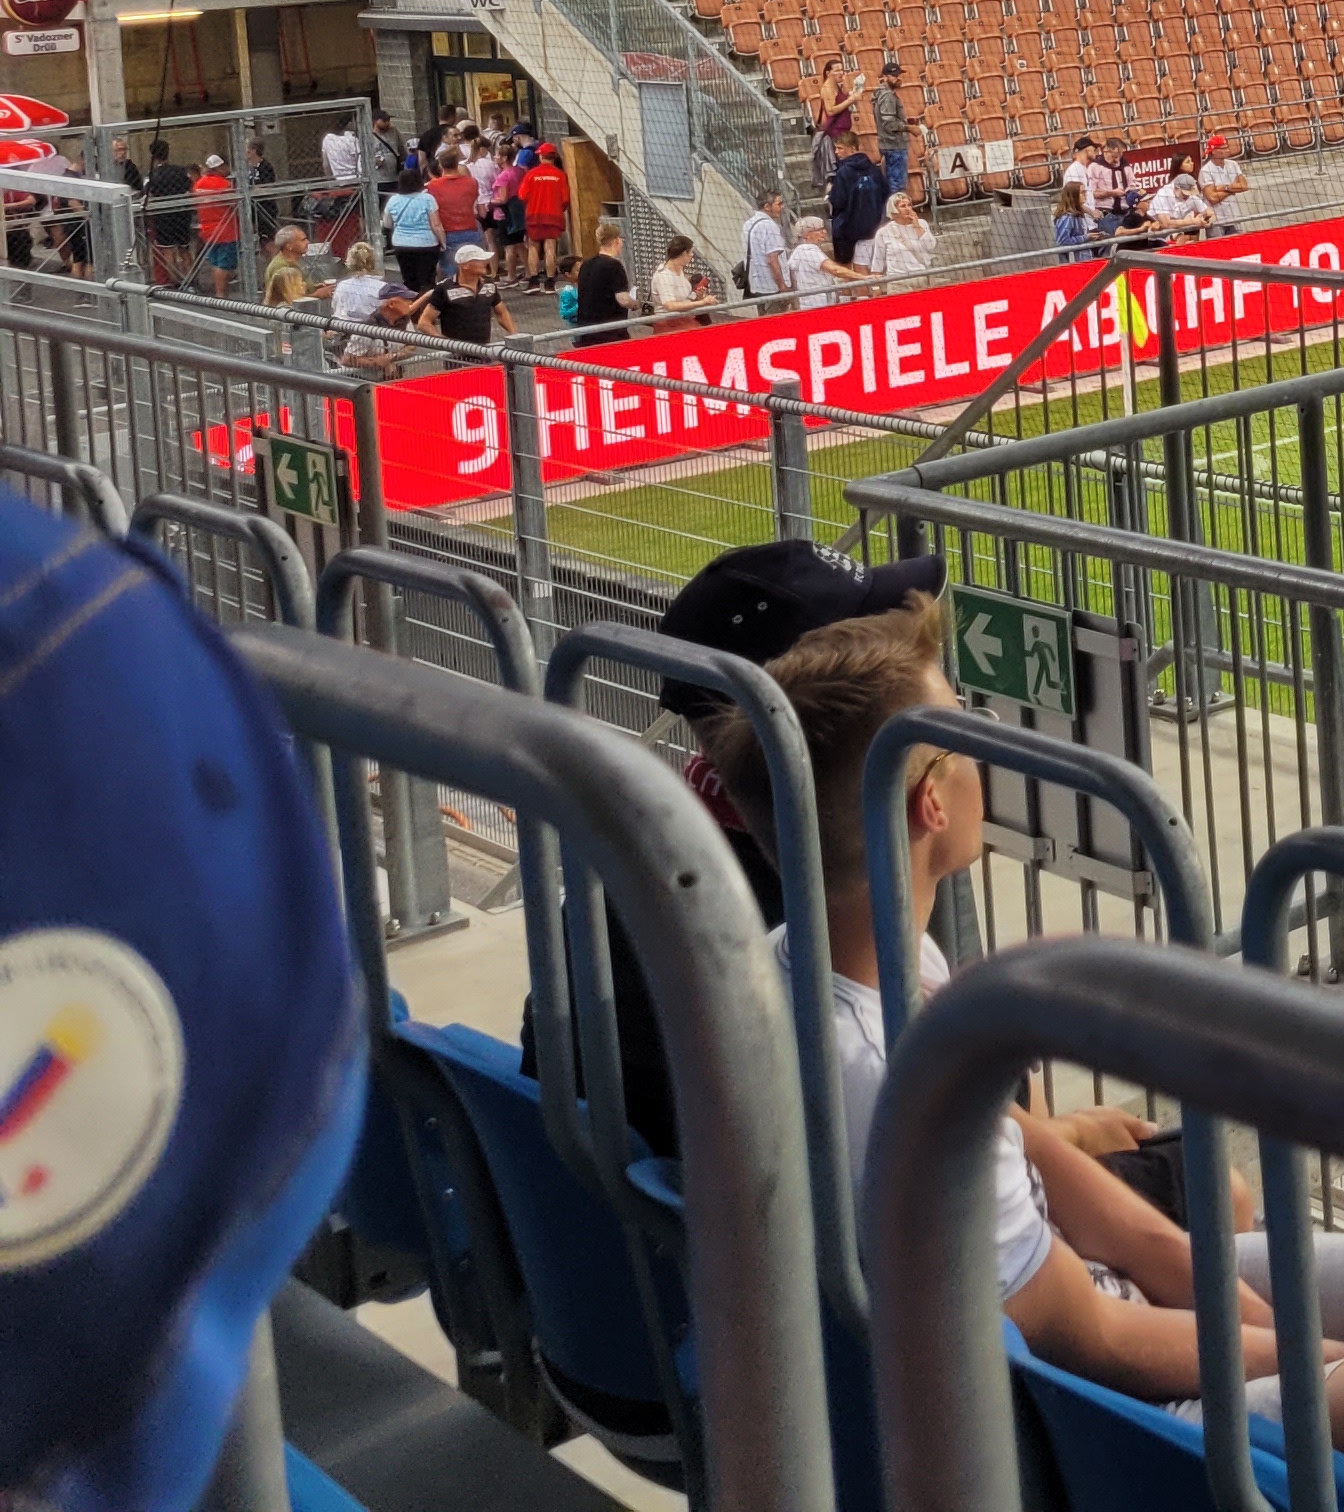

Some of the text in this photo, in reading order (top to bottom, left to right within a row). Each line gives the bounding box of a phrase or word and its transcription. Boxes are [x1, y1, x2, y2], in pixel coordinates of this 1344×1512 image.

[950, 151, 969, 174] A
[452, 394, 500, 476] 9
[535, 299, 1013, 459] HEIMSPIELE
[1040, 277, 1121, 353] AB
